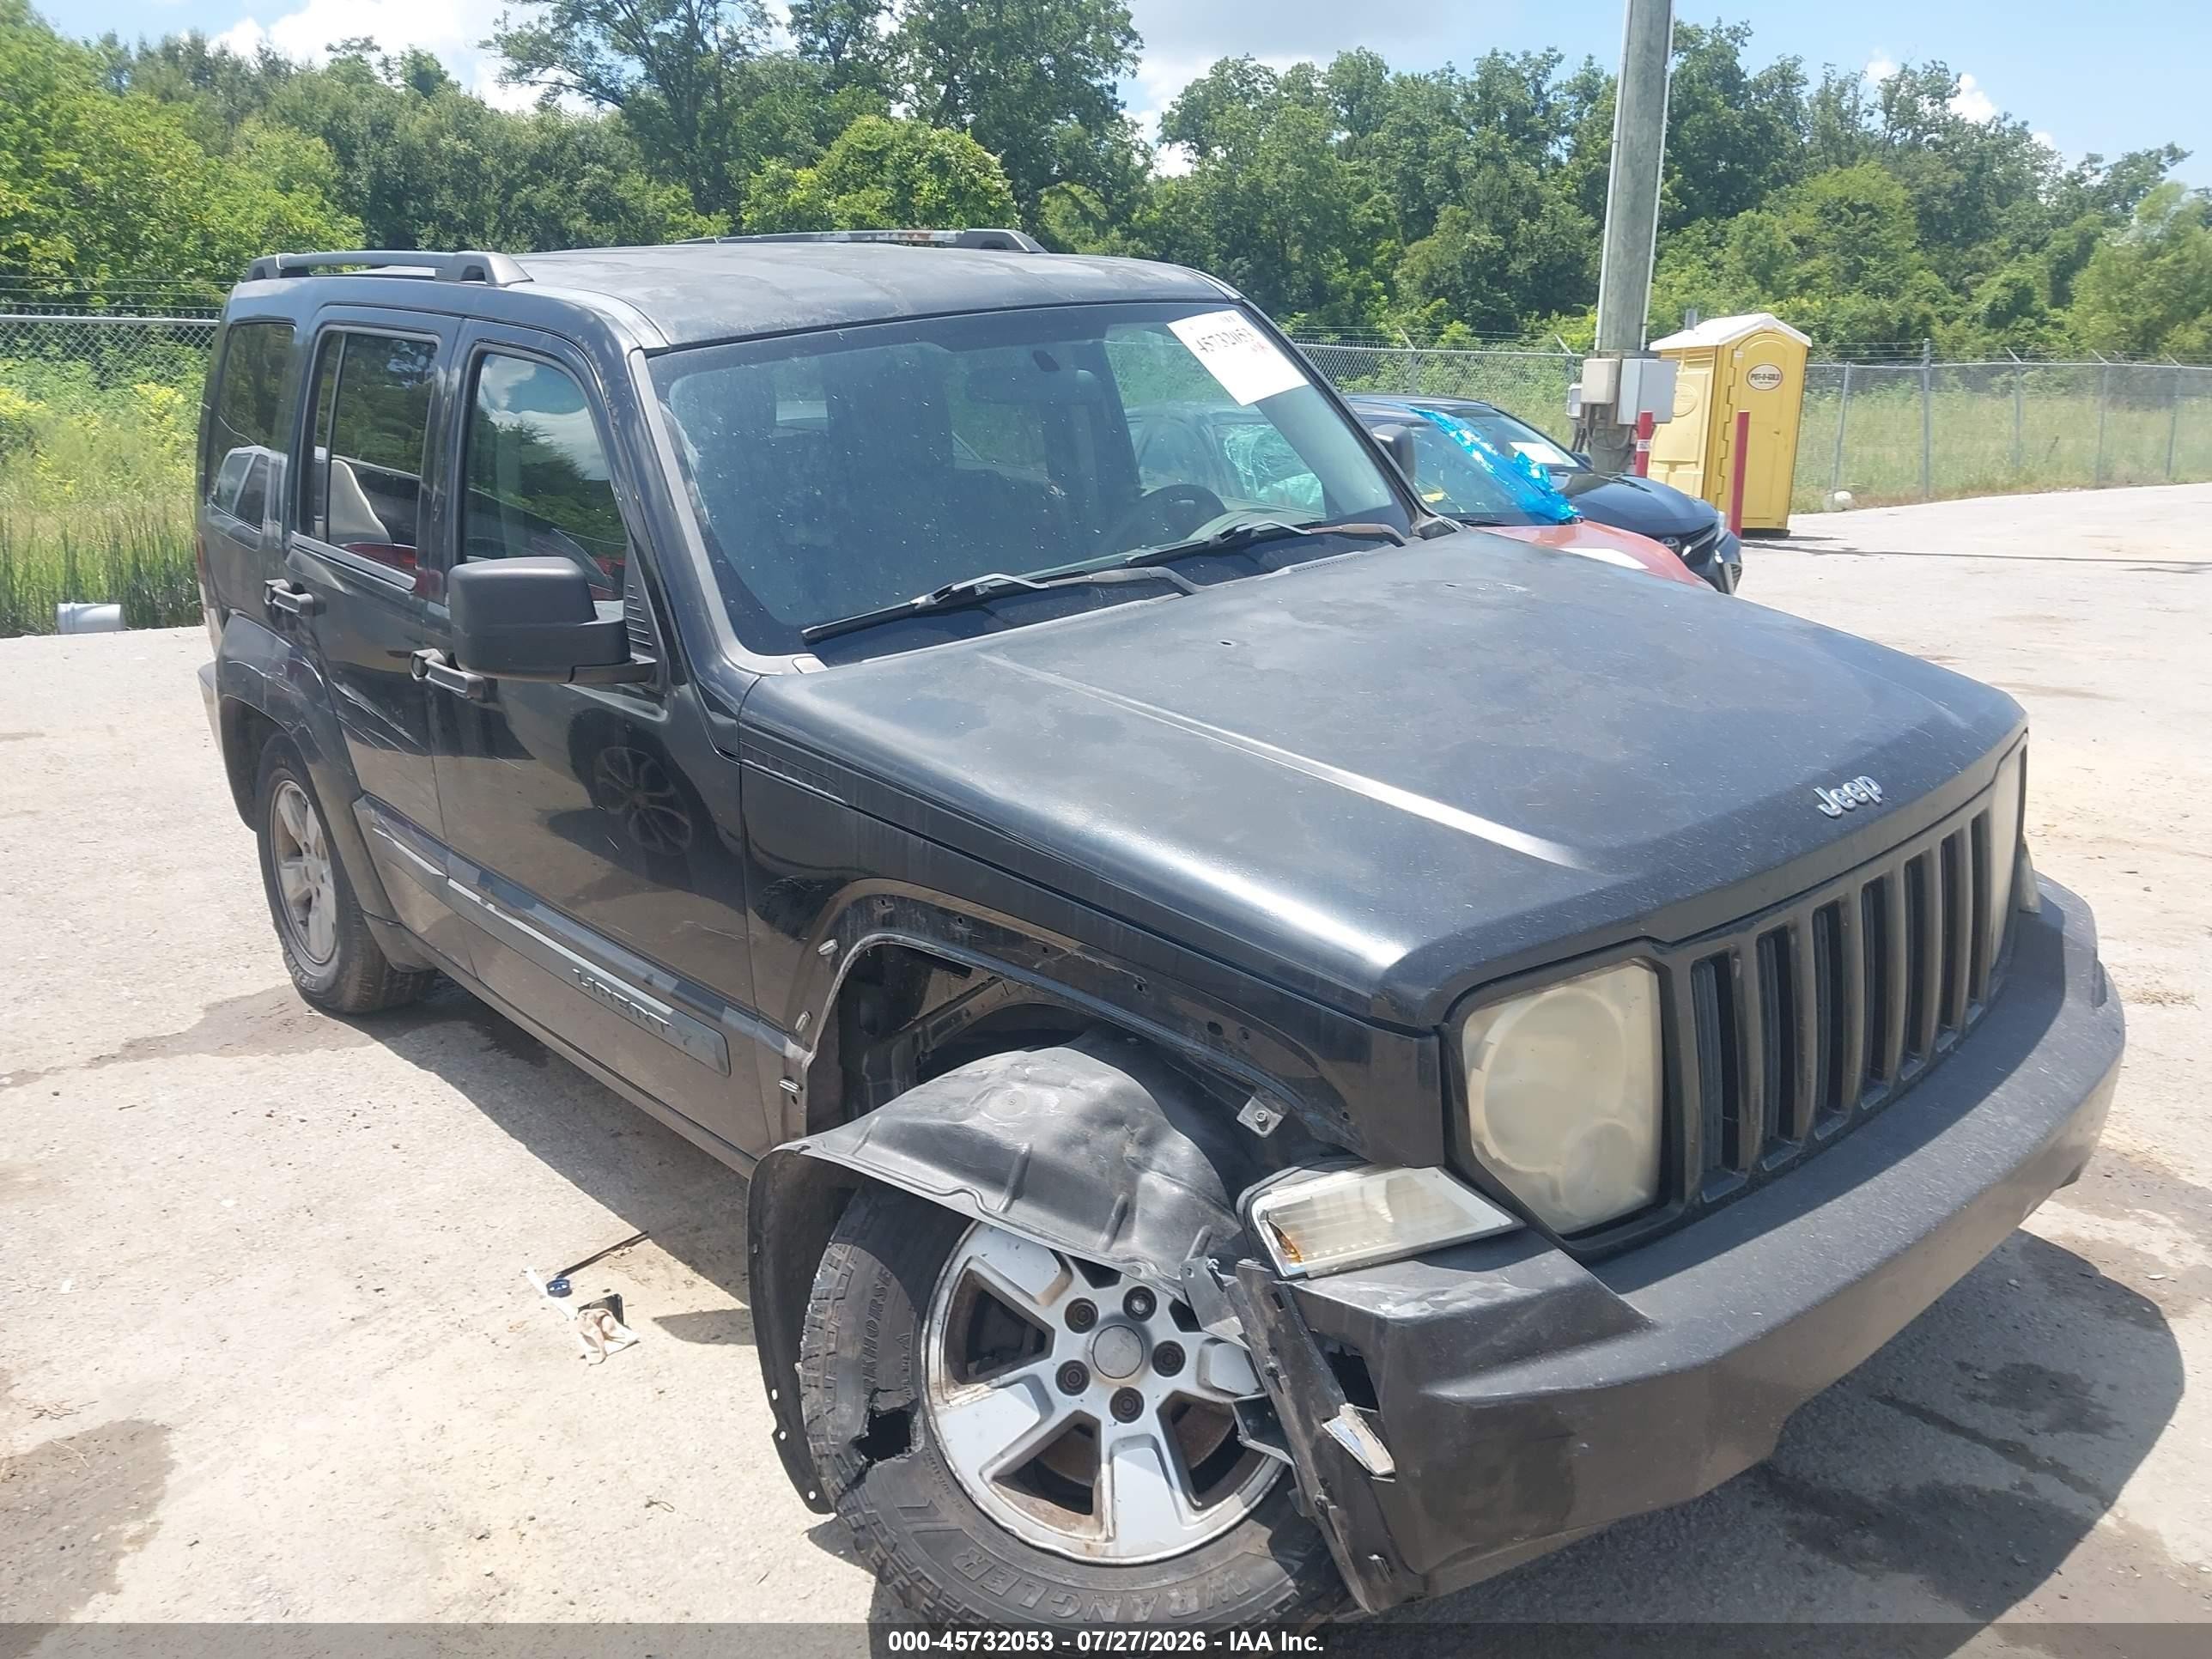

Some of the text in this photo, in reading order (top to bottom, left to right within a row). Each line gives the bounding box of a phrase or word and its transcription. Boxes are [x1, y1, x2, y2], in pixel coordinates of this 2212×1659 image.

[1196, 328, 1255, 353] 45732053
[1813, 775, 1883, 817] Jeep
[951, 1547, 1253, 1624] WRANGLER
